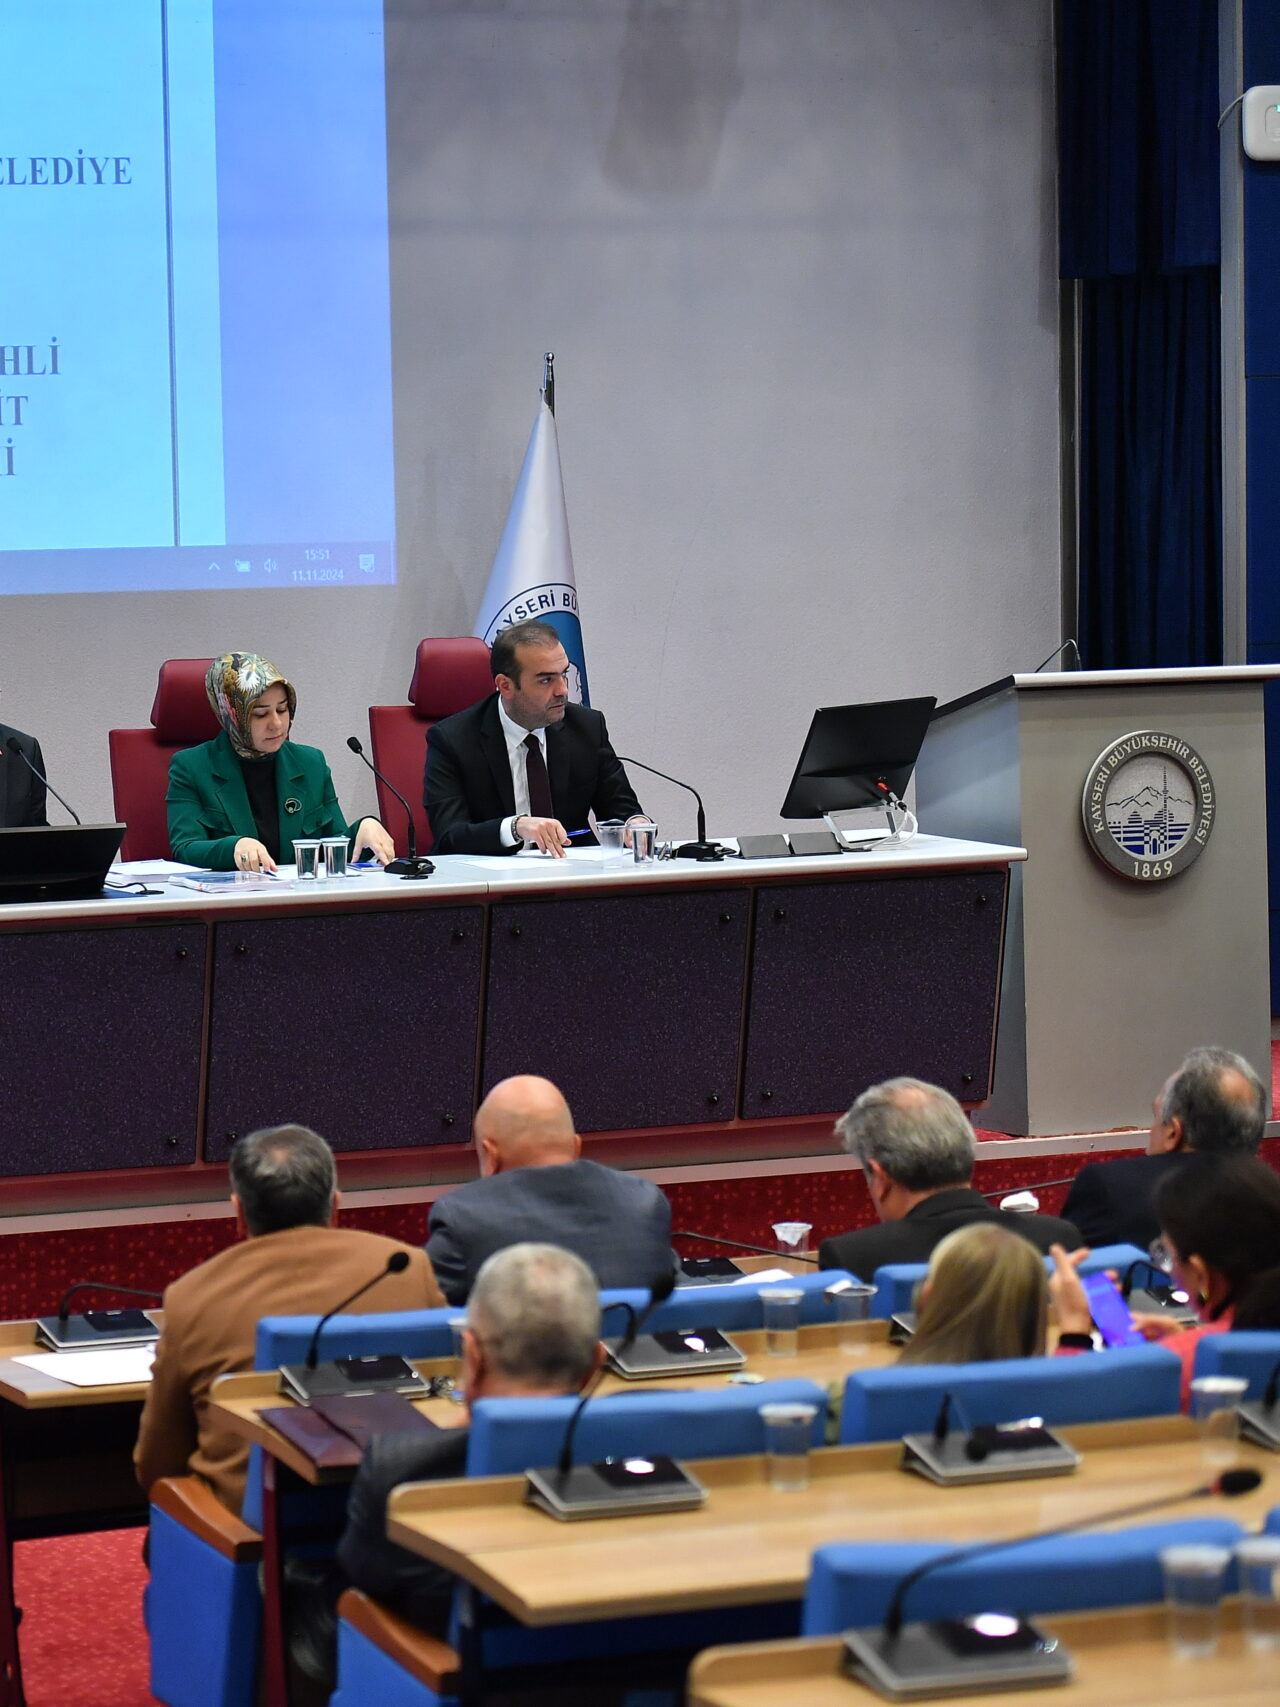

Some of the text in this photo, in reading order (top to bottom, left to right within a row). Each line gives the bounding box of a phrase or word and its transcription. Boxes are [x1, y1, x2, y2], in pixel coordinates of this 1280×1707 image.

[292, 569, 344, 581] 11.11.2024
[1091, 765, 1111, 833] KAYSERİ
[1188, 756, 1216, 846] BELEDİYESİ
[1133, 861, 1173, 878] 1869
